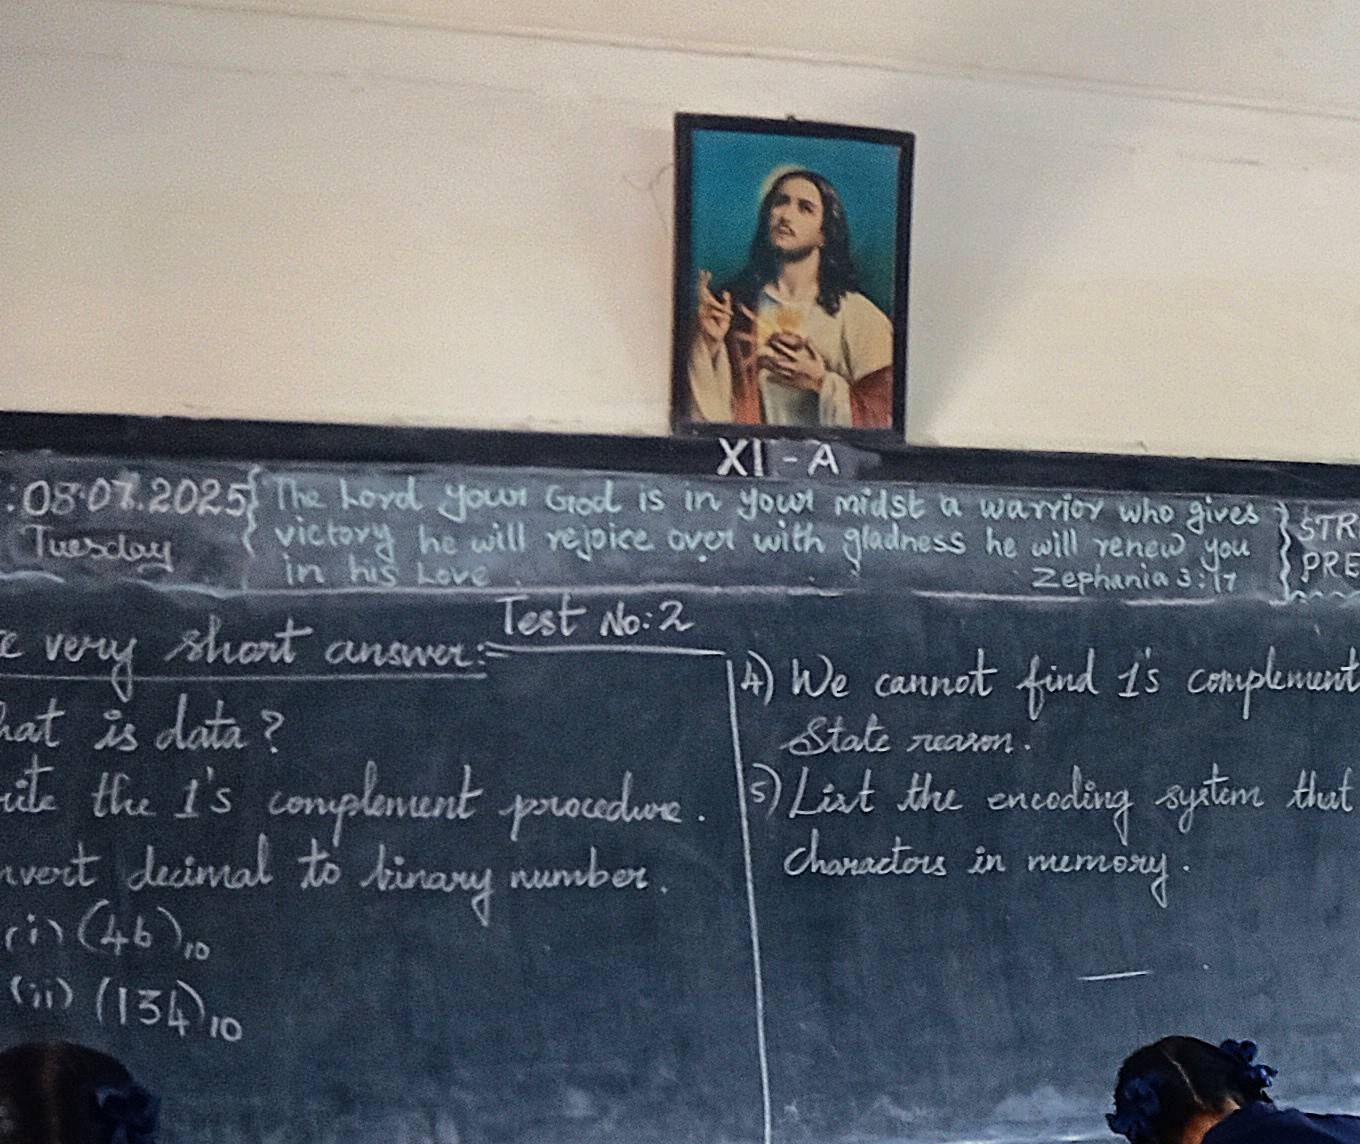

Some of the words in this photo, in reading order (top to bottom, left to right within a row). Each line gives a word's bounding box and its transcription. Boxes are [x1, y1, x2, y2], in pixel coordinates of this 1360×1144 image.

[808, 443, 840, 475] A
[273, 476, 327, 510] The
[340, 475, 423, 511] Lord
[437, 483, 527, 523] your
[545, 479, 621, 516] God
[639, 486, 665, 512] is
[684, 485, 722, 512] in
[737, 487, 814, 521] your
[834, 487, 925, 520] midst
[940, 492, 962, 517] a
[980, 493, 1104, 521] warrior
[1119, 497, 1175, 524] who
[1186, 495, 1260, 534] gives
[19, 524, 174, 573] Tuesday
[275, 516, 395, 563] victory
[419, 524, 456, 554] he
[471, 522, 525, 553] will
[547, 522, 654, 562] rejoice
[668, 528, 734, 552] over
[753, 518, 825, 554] with
[842, 522, 966, 577] gladness
[986, 526, 1017, 559] he
[1032, 527, 1078, 558] will
[1093, 532, 1186, 559] renew
[1201, 538, 1251, 572] you
[283, 552, 324, 585] in
[350, 553, 396, 587] his
[1032, 563, 1169, 595] Zephania
[495, 592, 587, 637] Test
[45, 632, 138, 703] very
[163, 614, 313, 664] short
[792, 654, 849, 697] We
[874, 648, 998, 697] cannot
[1016, 648, 1099, 721] find
[1117, 647, 1160, 698] 1's
[94, 709, 139, 751] is
[779, 713, 891, 756] State
[91, 771, 156, 817] the
[174, 765, 232, 818] 1's
[268, 759, 484, 847] complement
[789, 766, 875, 819] List
[897, 772, 963, 812] the
[987, 765, 1134, 846] encoding
[1155, 762, 1264, 834] system
[1287, 767, 1353, 813] that
[126, 832, 273, 891] decimal
[299, 838, 342, 888] to
[360, 843, 492, 927] binary
[969, 846, 1007, 875] in
